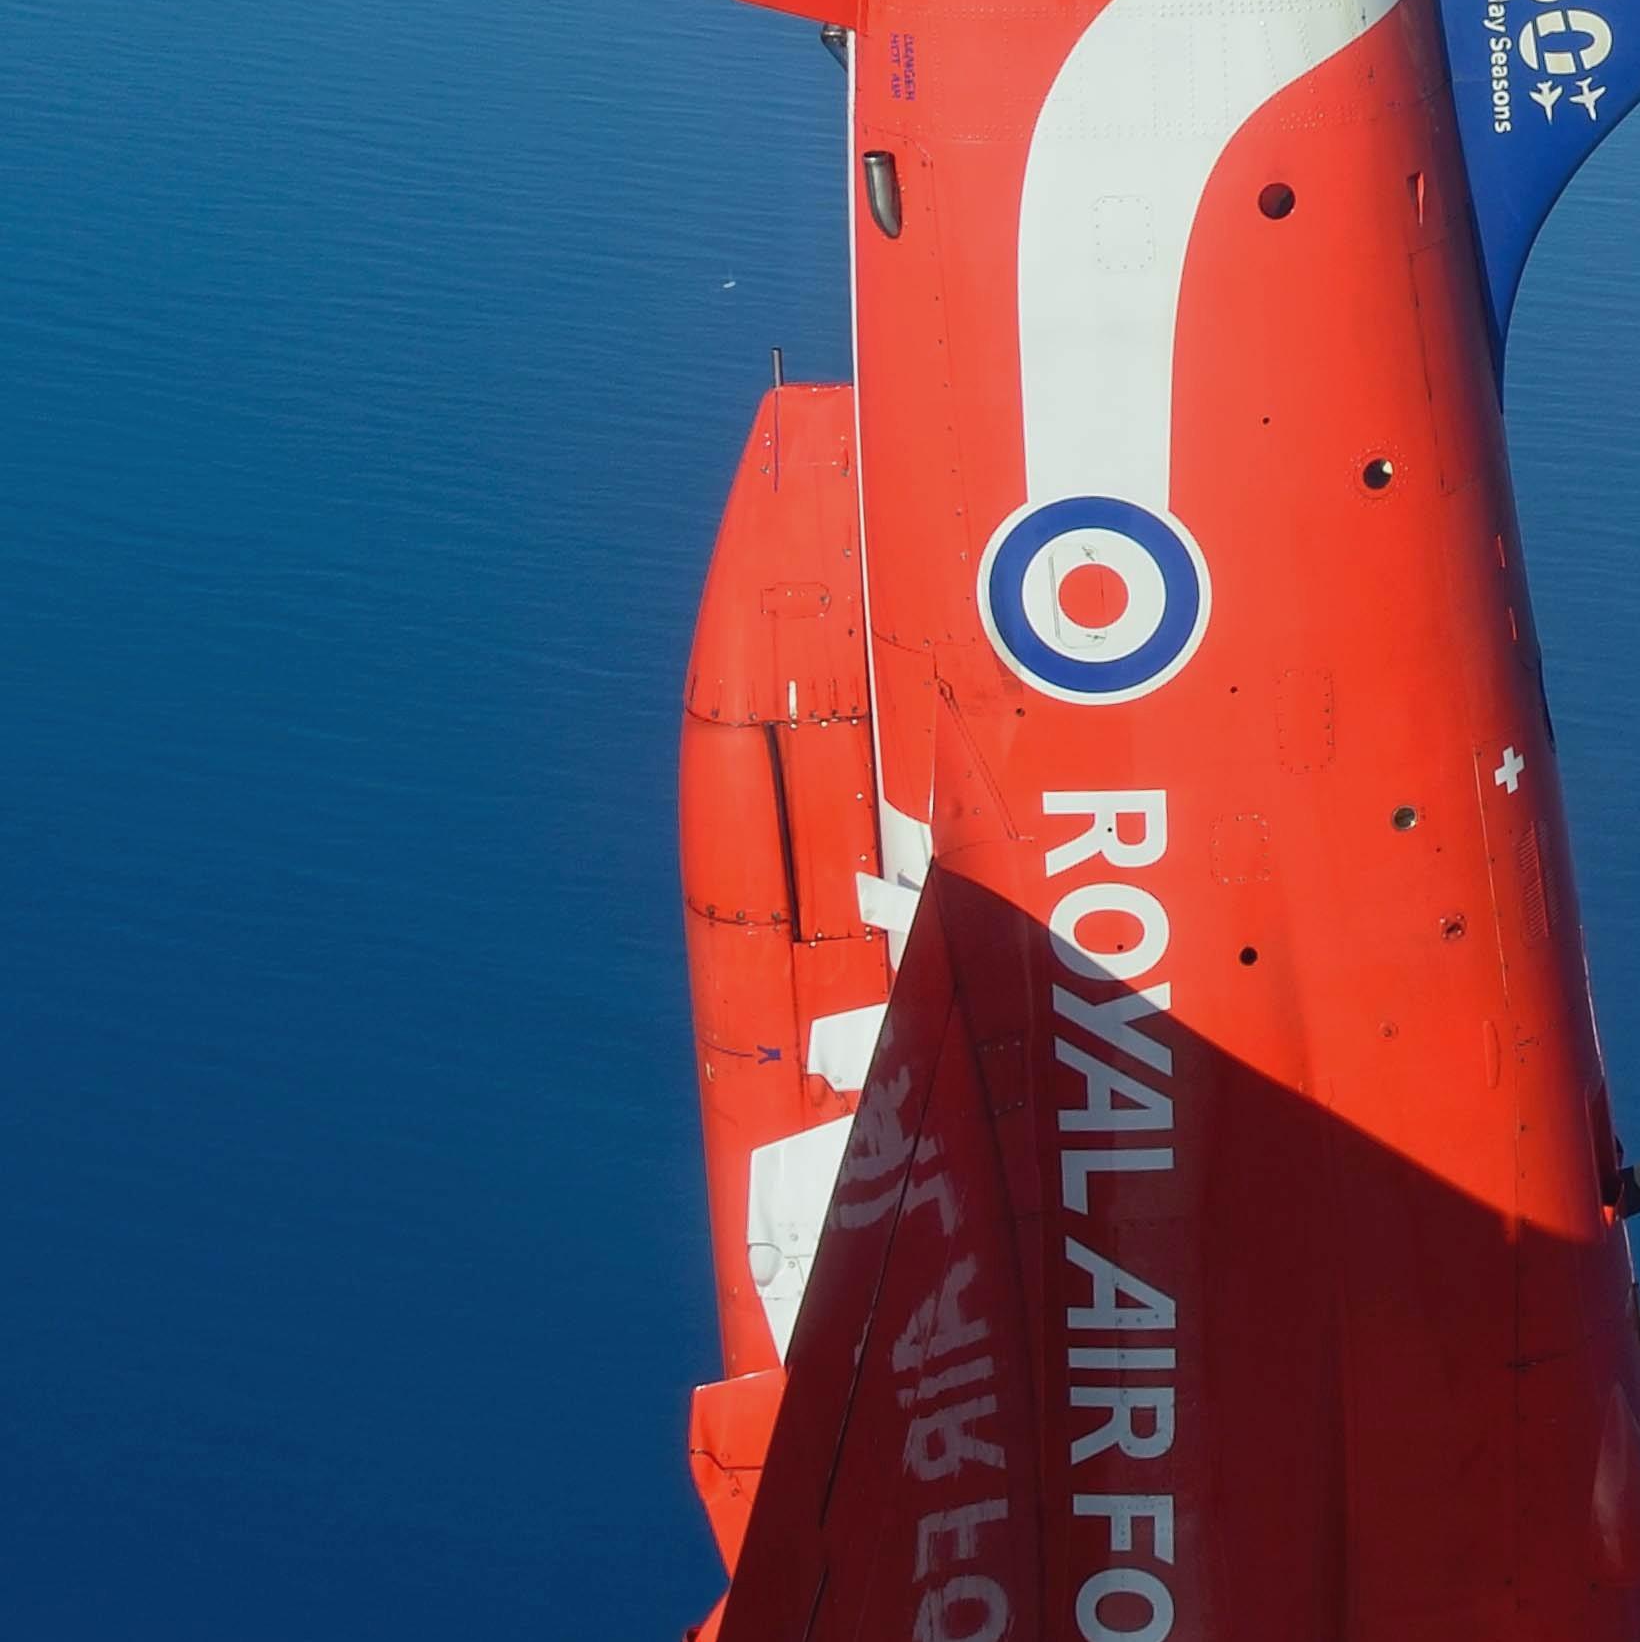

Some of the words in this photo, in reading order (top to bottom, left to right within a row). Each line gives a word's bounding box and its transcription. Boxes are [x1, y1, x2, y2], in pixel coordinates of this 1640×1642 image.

[1488, 36, 1513, 134] Seasons
[1041, 788, 1174, 1215] ROYAL
[1064, 1236, 1177, 1468] AIR
